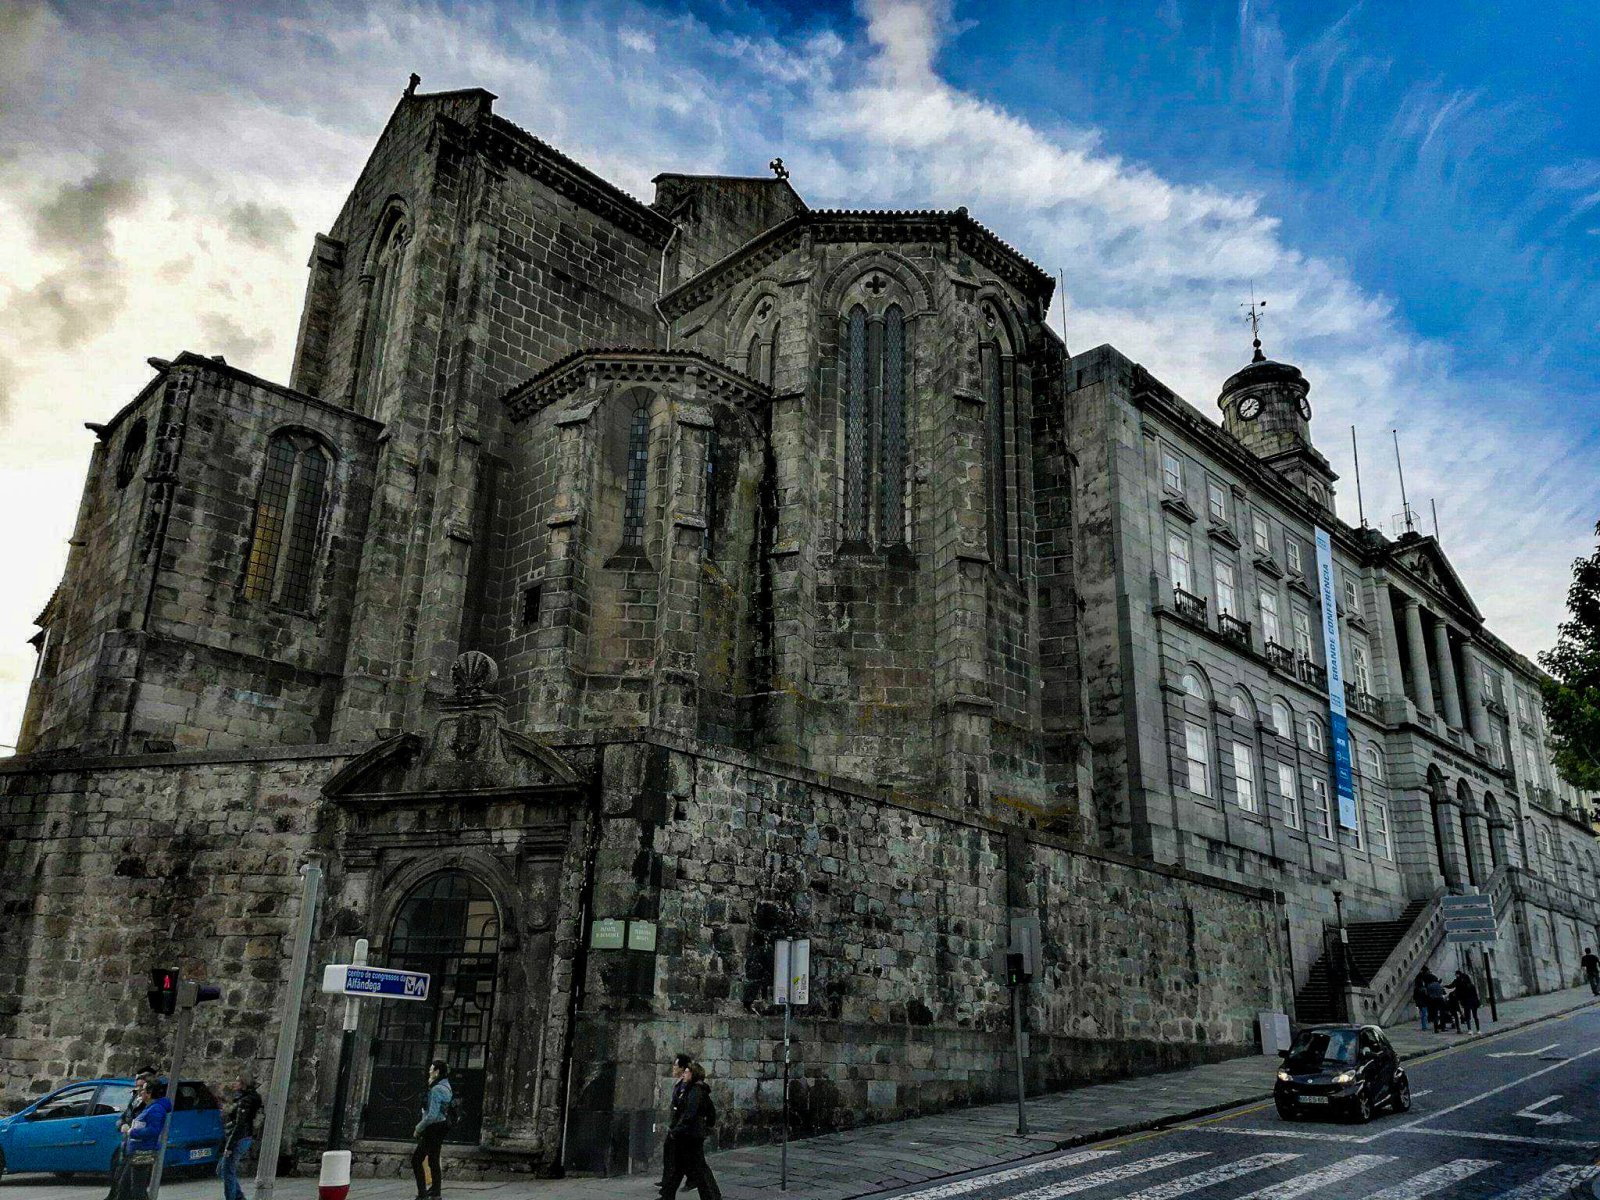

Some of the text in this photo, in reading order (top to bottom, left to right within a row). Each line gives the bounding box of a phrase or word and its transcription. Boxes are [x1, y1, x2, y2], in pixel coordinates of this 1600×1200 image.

[1329, 638, 1339, 681] GRANDE
[347, 970, 364, 978] centro
[372, 973, 399, 981] congressos
